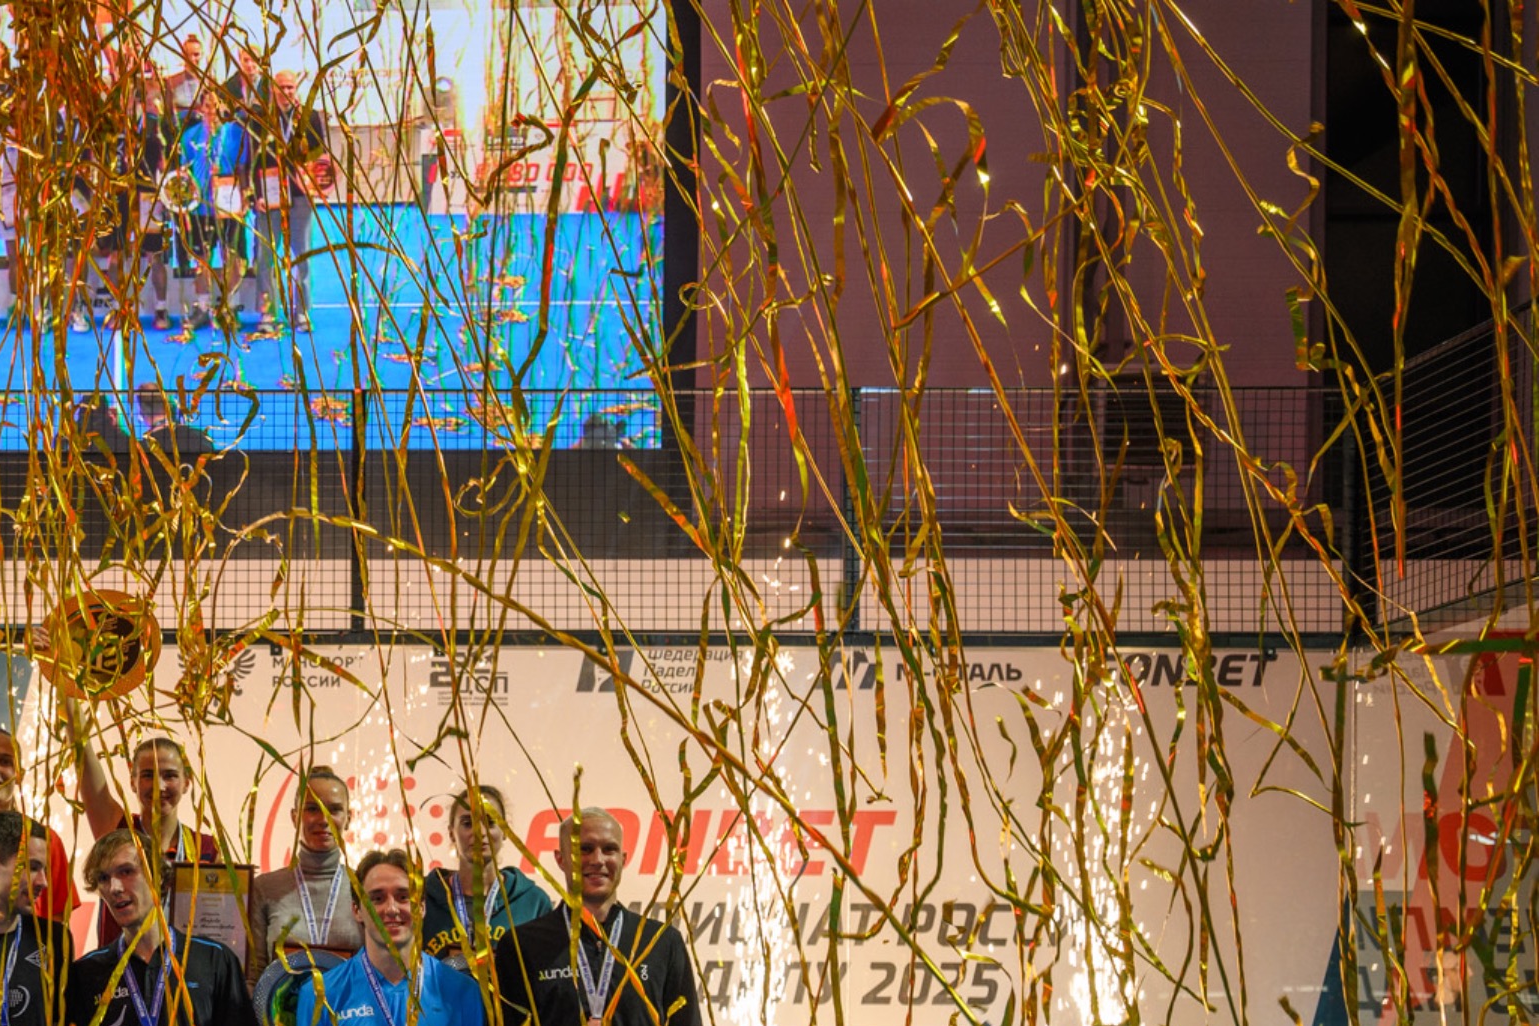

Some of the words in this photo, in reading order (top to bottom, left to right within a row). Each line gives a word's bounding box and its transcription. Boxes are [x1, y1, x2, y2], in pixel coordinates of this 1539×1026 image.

[643, 663, 704, 679] Падел
[272, 676, 341, 688] РОСИИ
[861, 962, 1001, 1005] 2025
